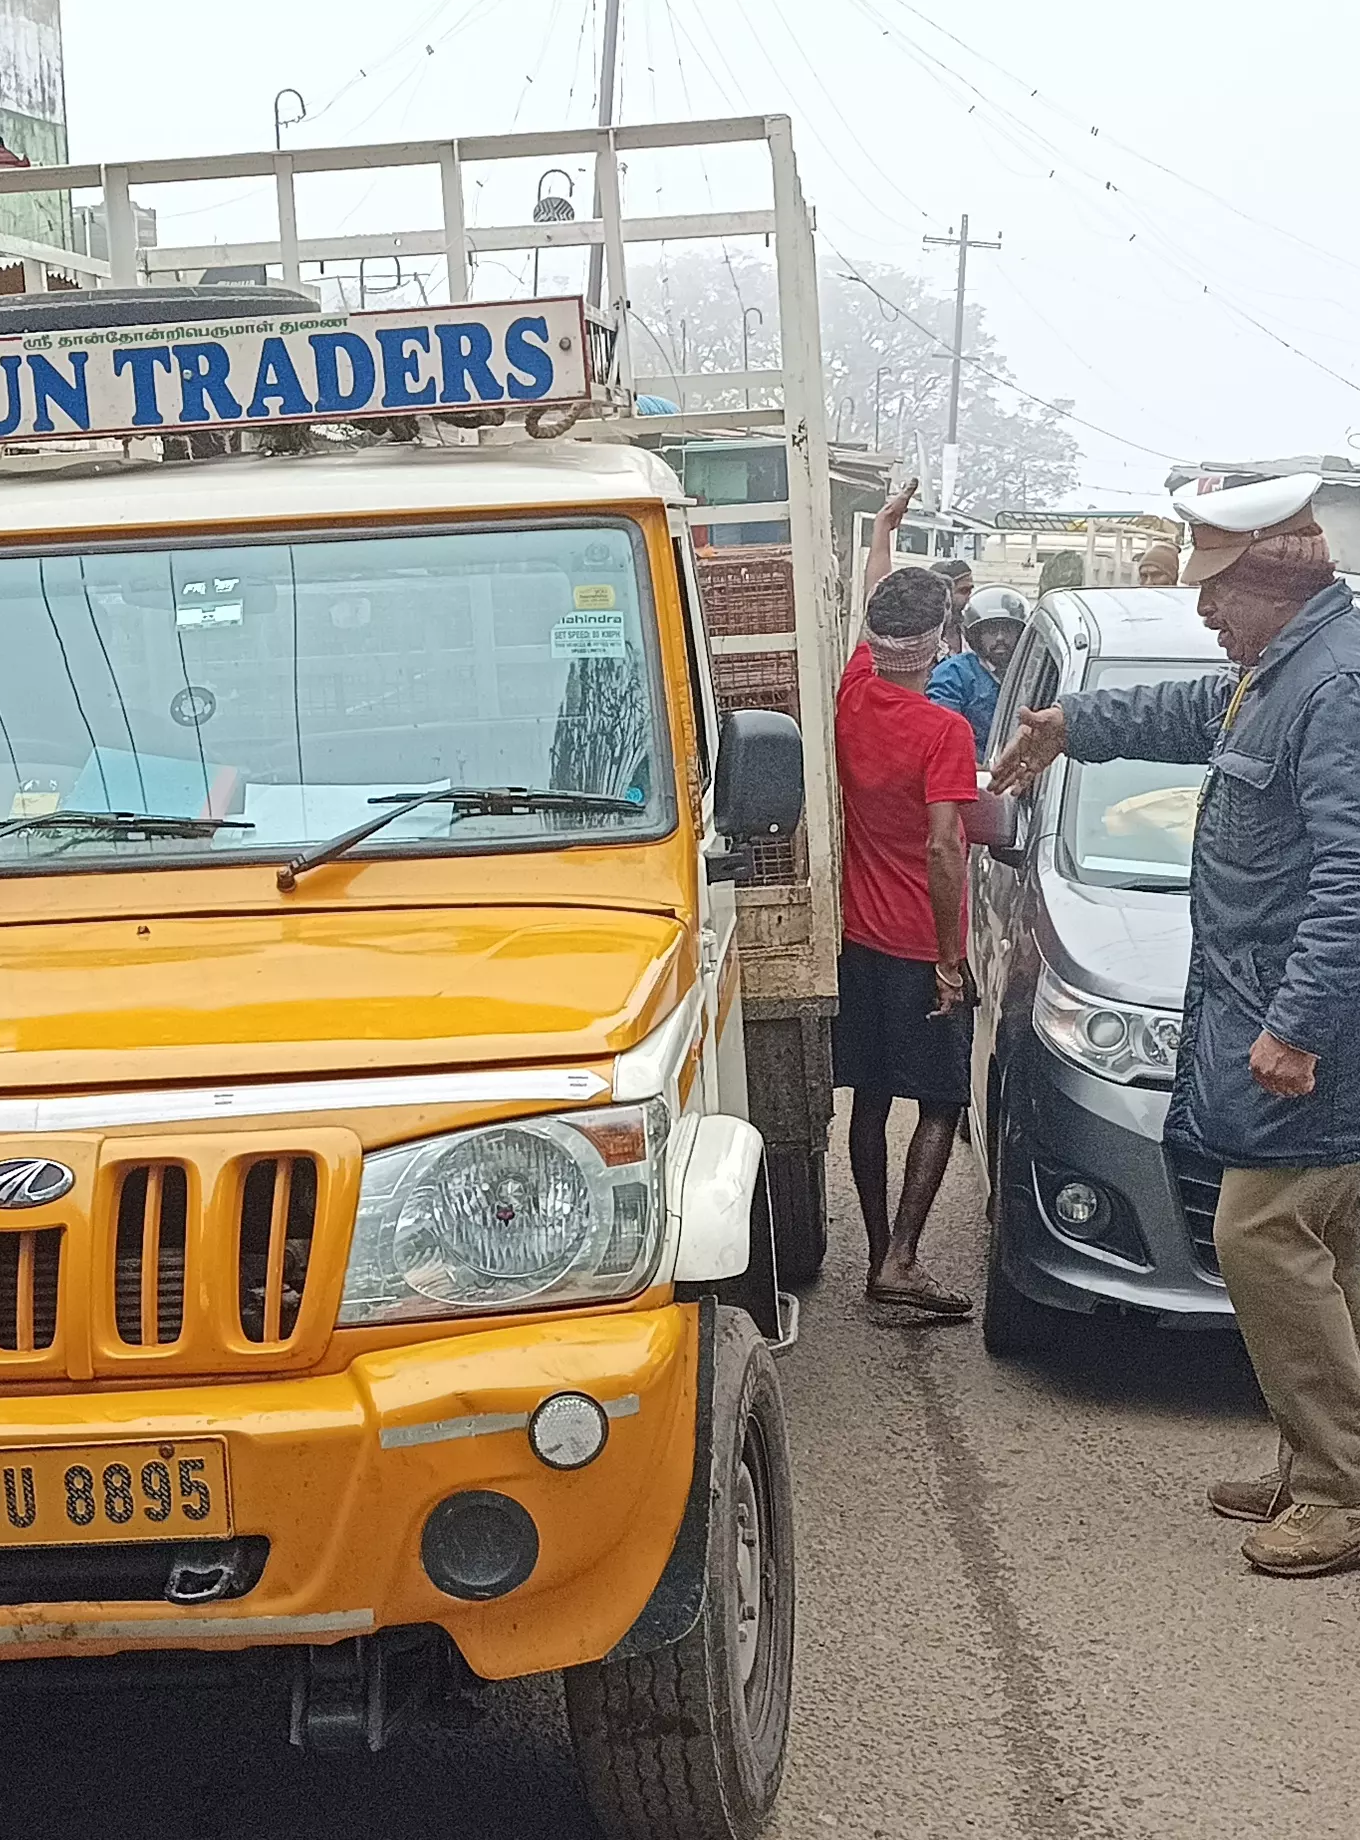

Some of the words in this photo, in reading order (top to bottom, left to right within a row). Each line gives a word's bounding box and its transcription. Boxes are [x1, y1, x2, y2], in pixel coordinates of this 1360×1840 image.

[279, 316, 349, 336] துணை
[114, 316, 557, 426] TRADERS
[63, 1454, 211, 1526] 8895
